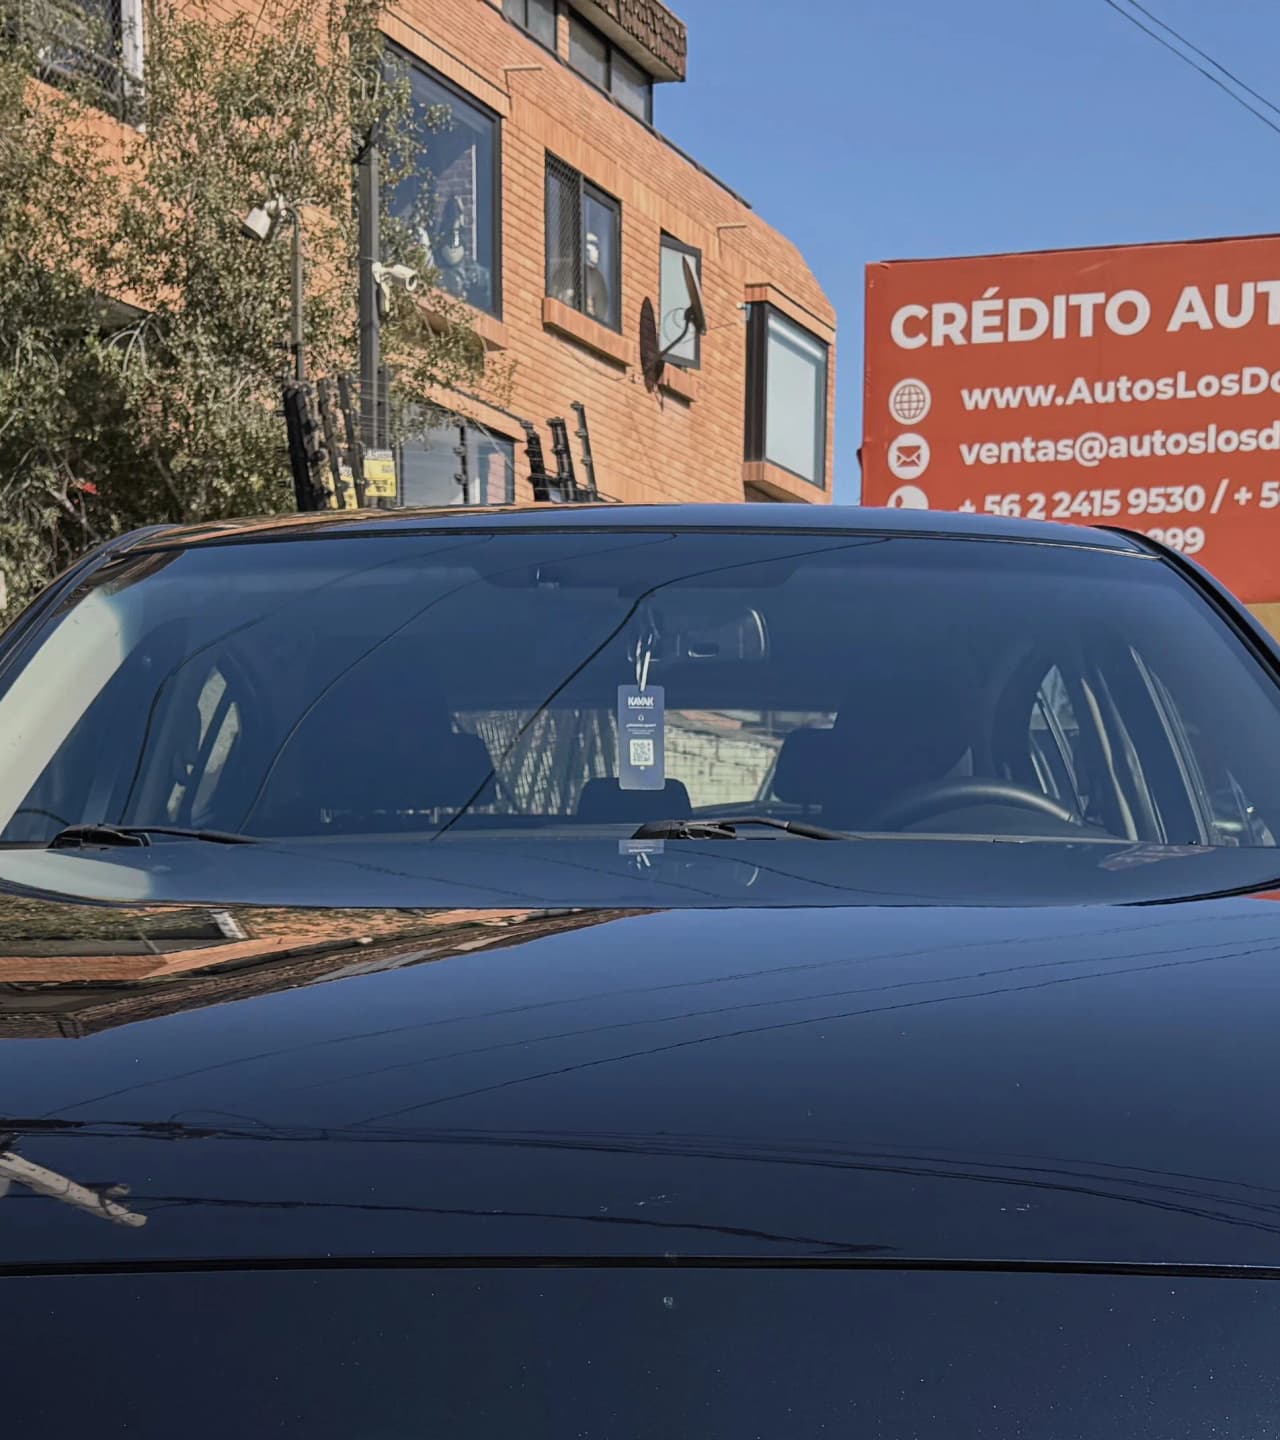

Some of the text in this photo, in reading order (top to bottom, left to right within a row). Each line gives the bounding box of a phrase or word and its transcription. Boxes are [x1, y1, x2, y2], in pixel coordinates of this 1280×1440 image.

[890, 286, 1152, 350] CRÉDITO
[1051, 489, 1121, 518] 2415
[1127, 484, 1206, 515] 9530
